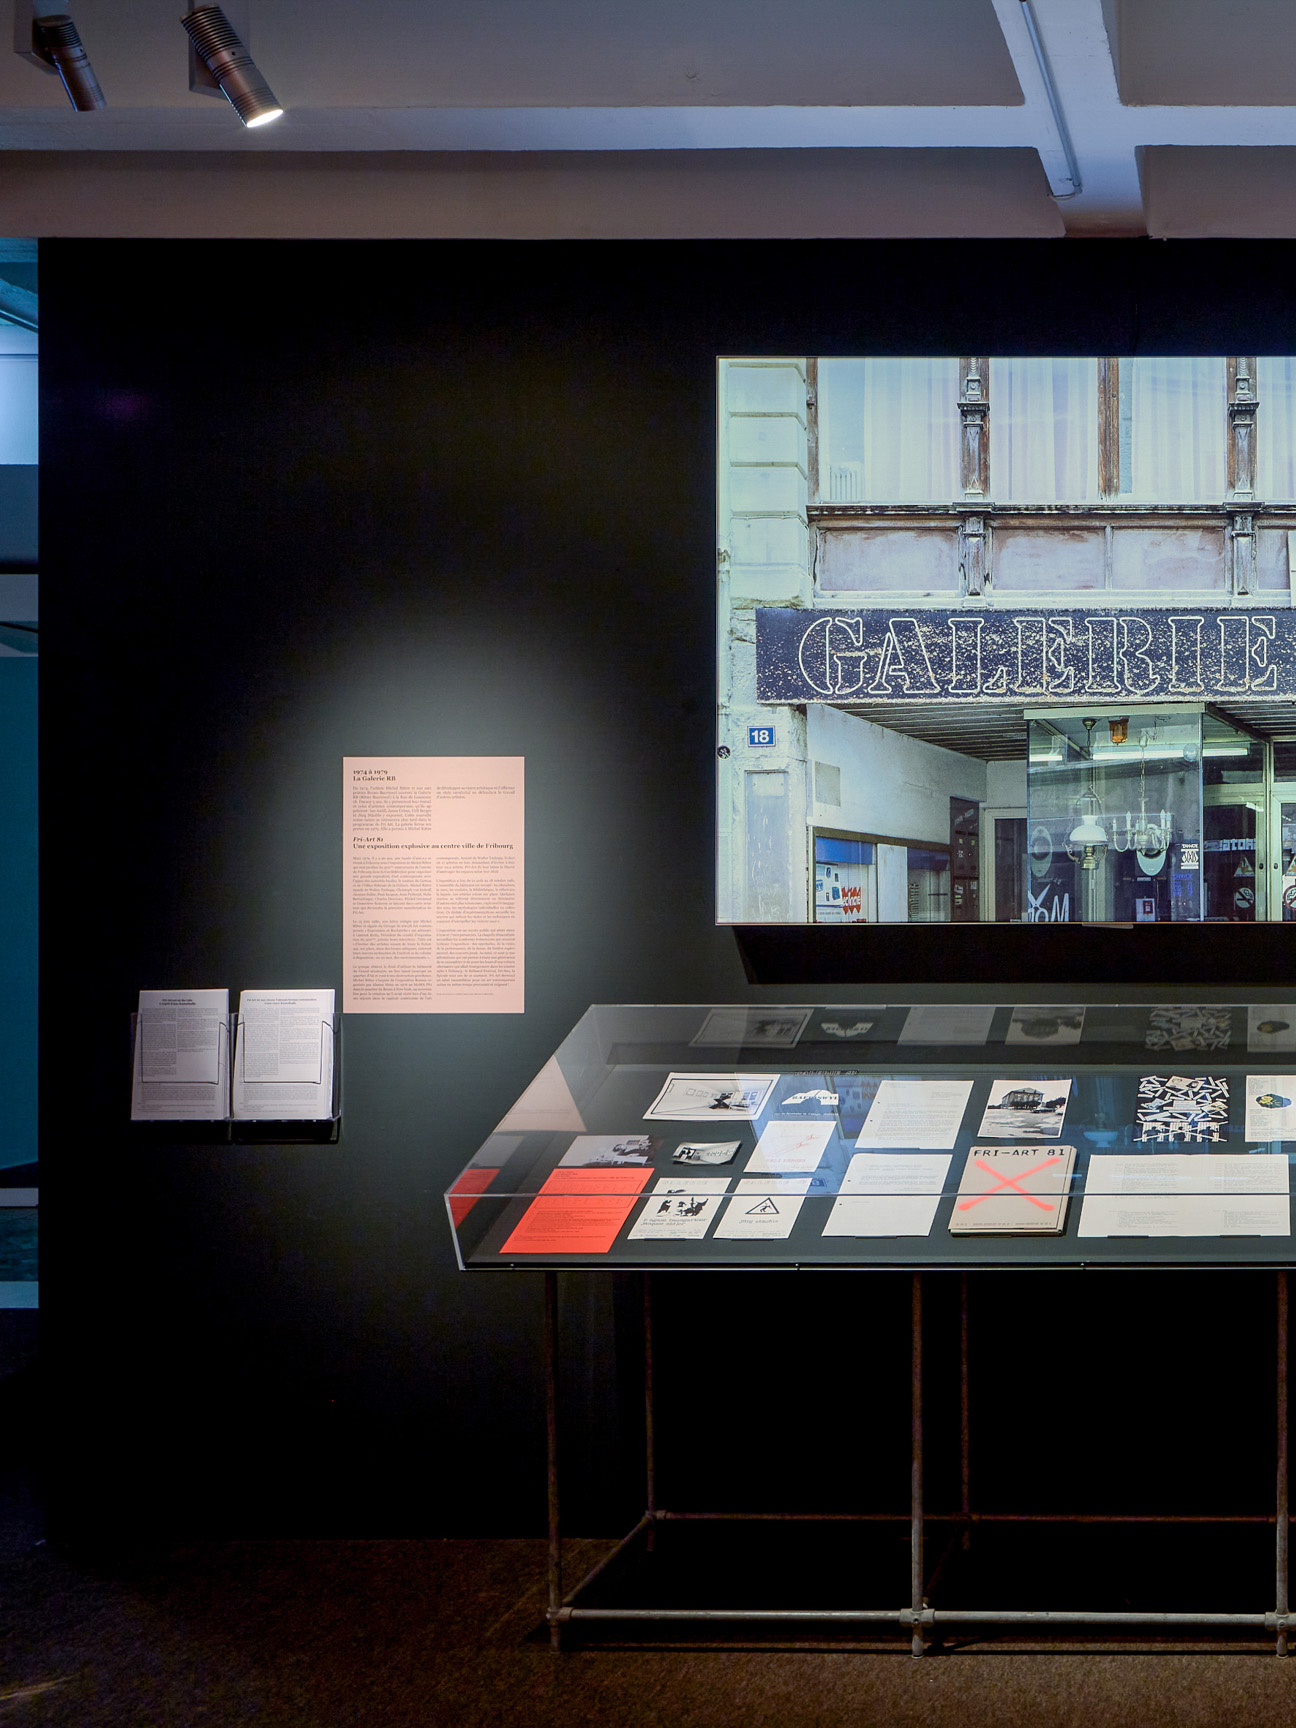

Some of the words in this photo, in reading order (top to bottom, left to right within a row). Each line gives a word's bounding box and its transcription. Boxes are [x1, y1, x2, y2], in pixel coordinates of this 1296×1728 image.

[799, 616, 1278, 695] GALERIE
[751, 730, 770, 743] 18
[973, 1148, 1040, 1157] FRI-ART
[1046, 1148, 1065, 1156] 81
